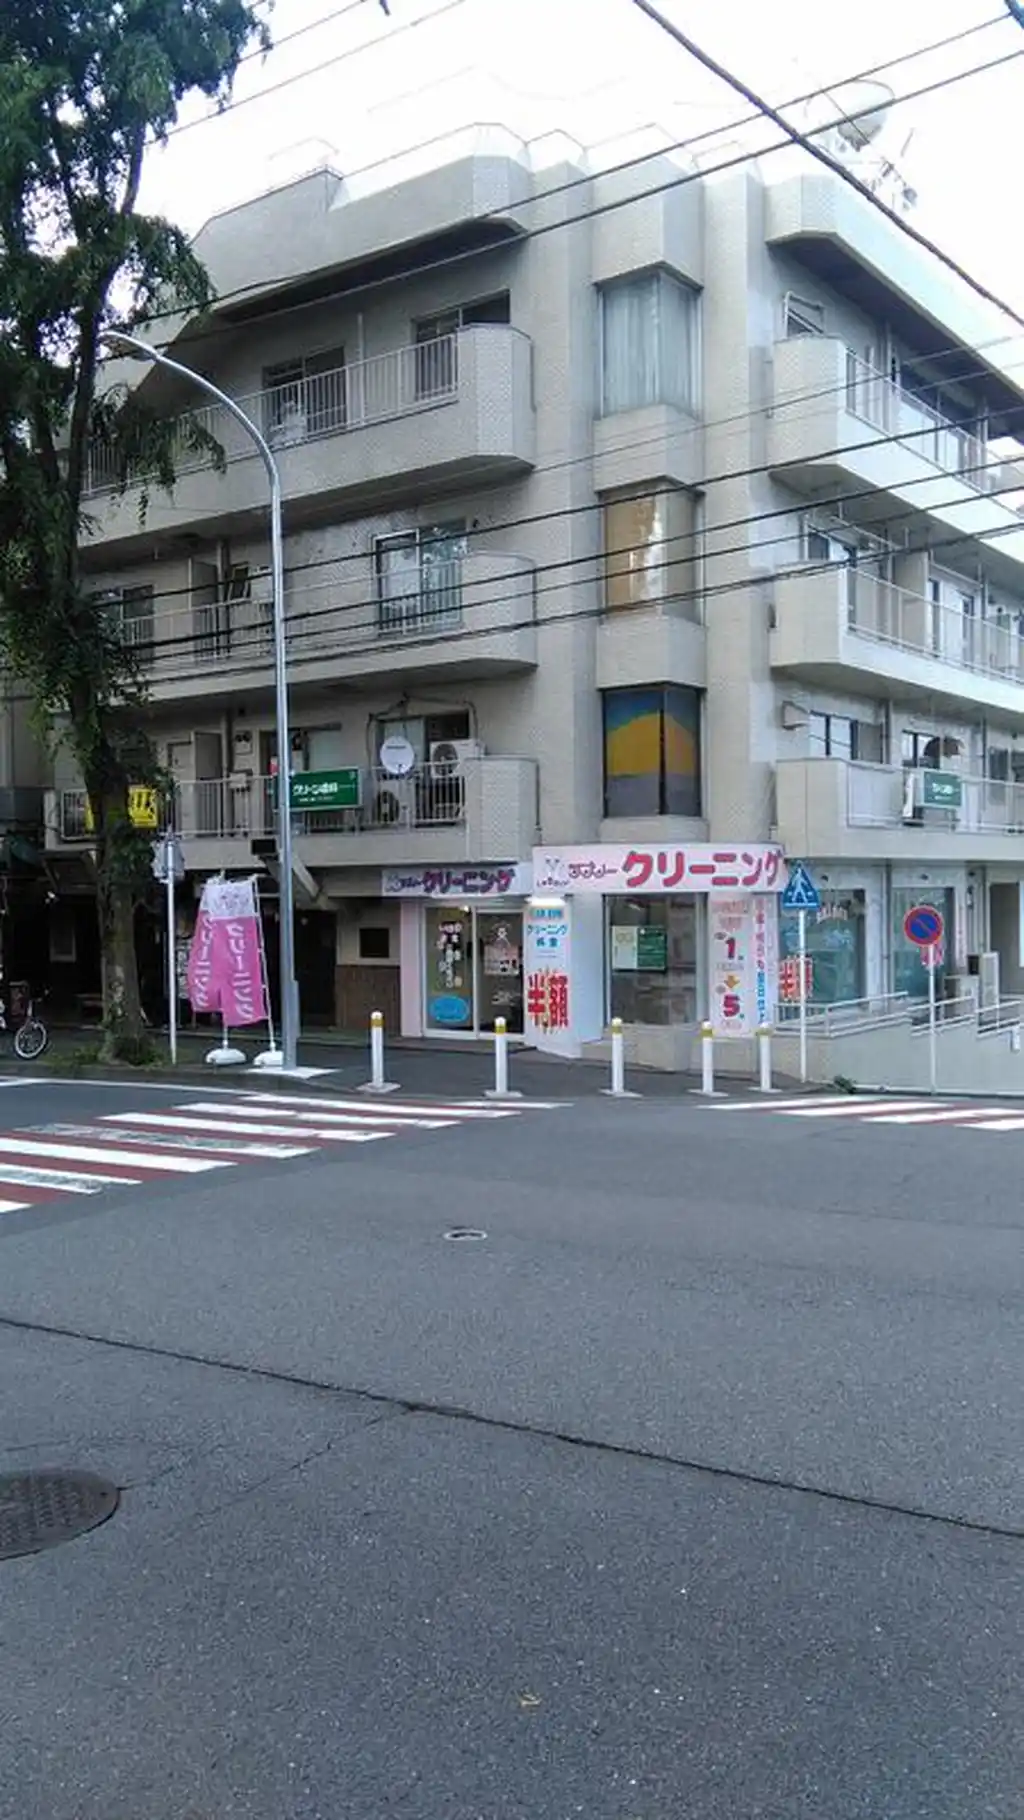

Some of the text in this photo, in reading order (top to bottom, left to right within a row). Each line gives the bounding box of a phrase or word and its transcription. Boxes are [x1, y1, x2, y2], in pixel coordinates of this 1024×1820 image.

[423, 868, 516, 894] クリーニング
[622, 850, 783, 887] クリーニング
[226, 921, 255, 1019] クリーニング
[527, 972, 569, 1028] 半額
